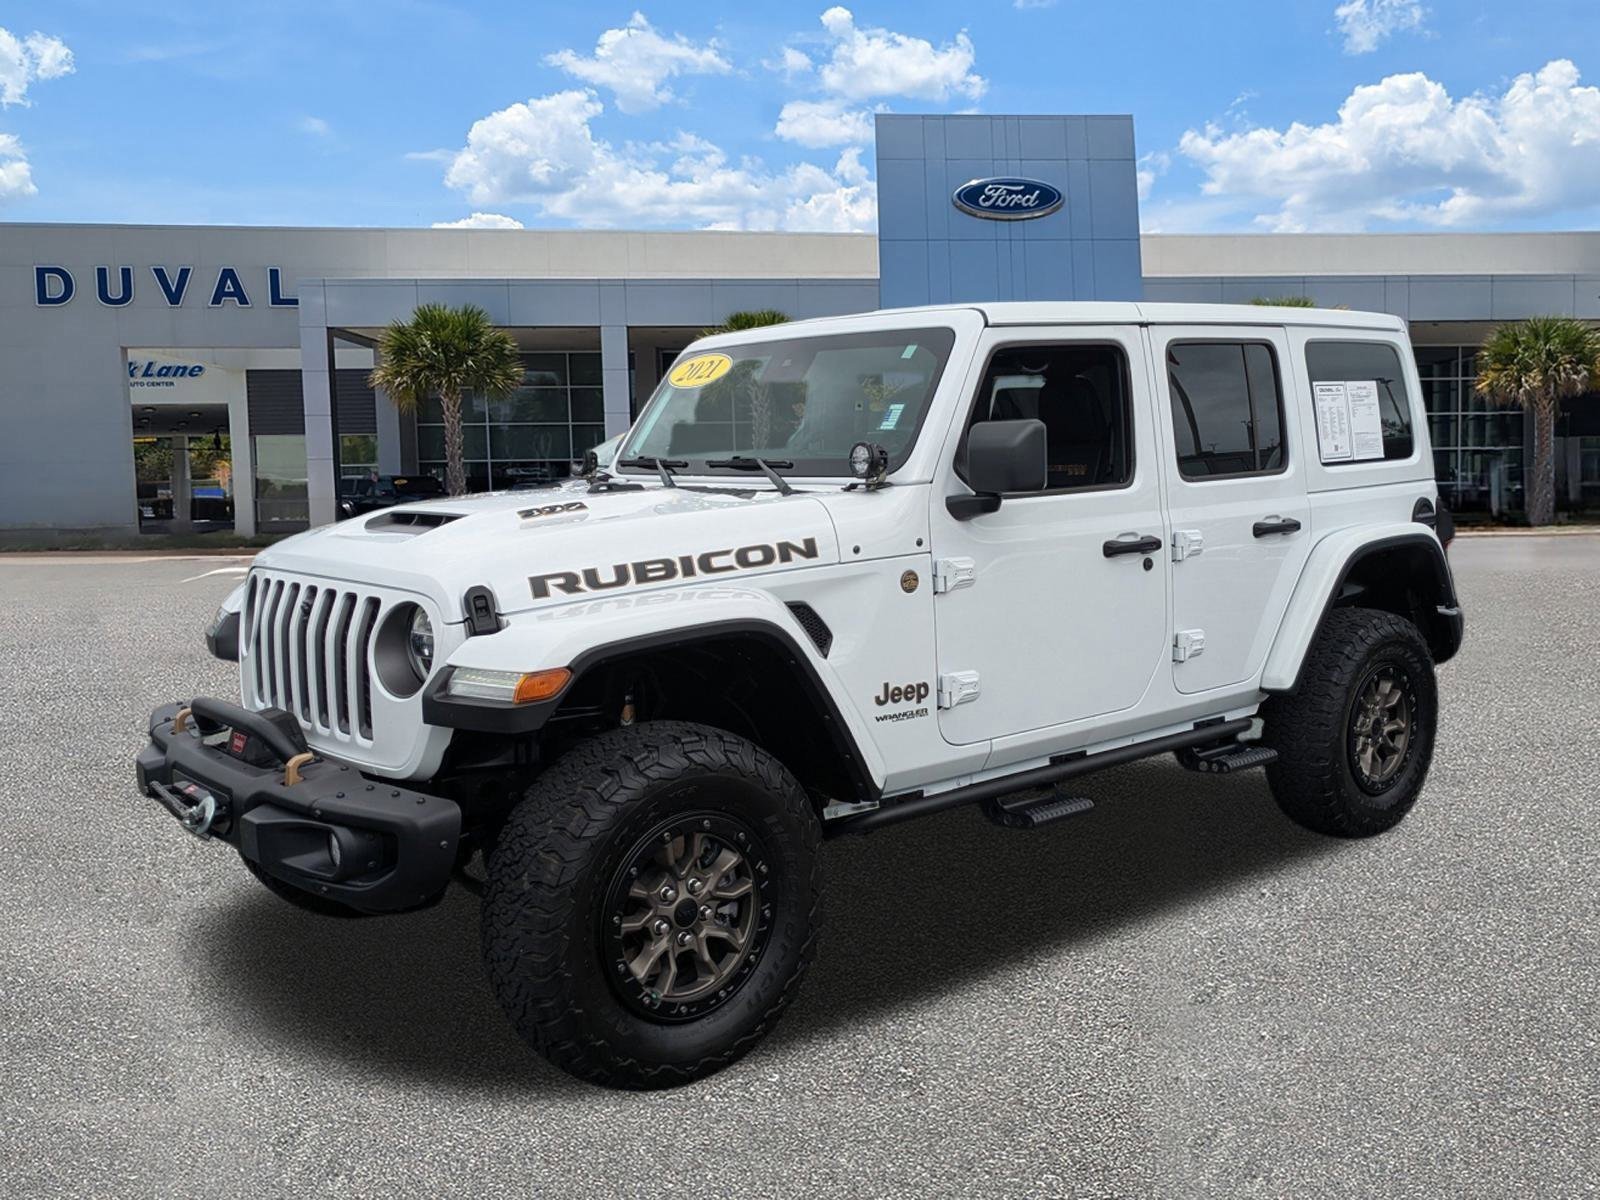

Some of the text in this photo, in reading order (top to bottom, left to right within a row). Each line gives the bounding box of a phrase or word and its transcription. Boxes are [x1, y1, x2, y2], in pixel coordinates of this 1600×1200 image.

[979, 184, 1040, 207] Ford
[33, 265, 299, 307] DUVAL
[142, 361, 204, 378] Lane
[675, 359, 725, 382] 2021
[517, 501, 588, 520] 392
[528, 537, 819, 600] RUBICON
[875, 682, 929, 706] Jeep
[875, 708, 928, 722] WRANGLER
